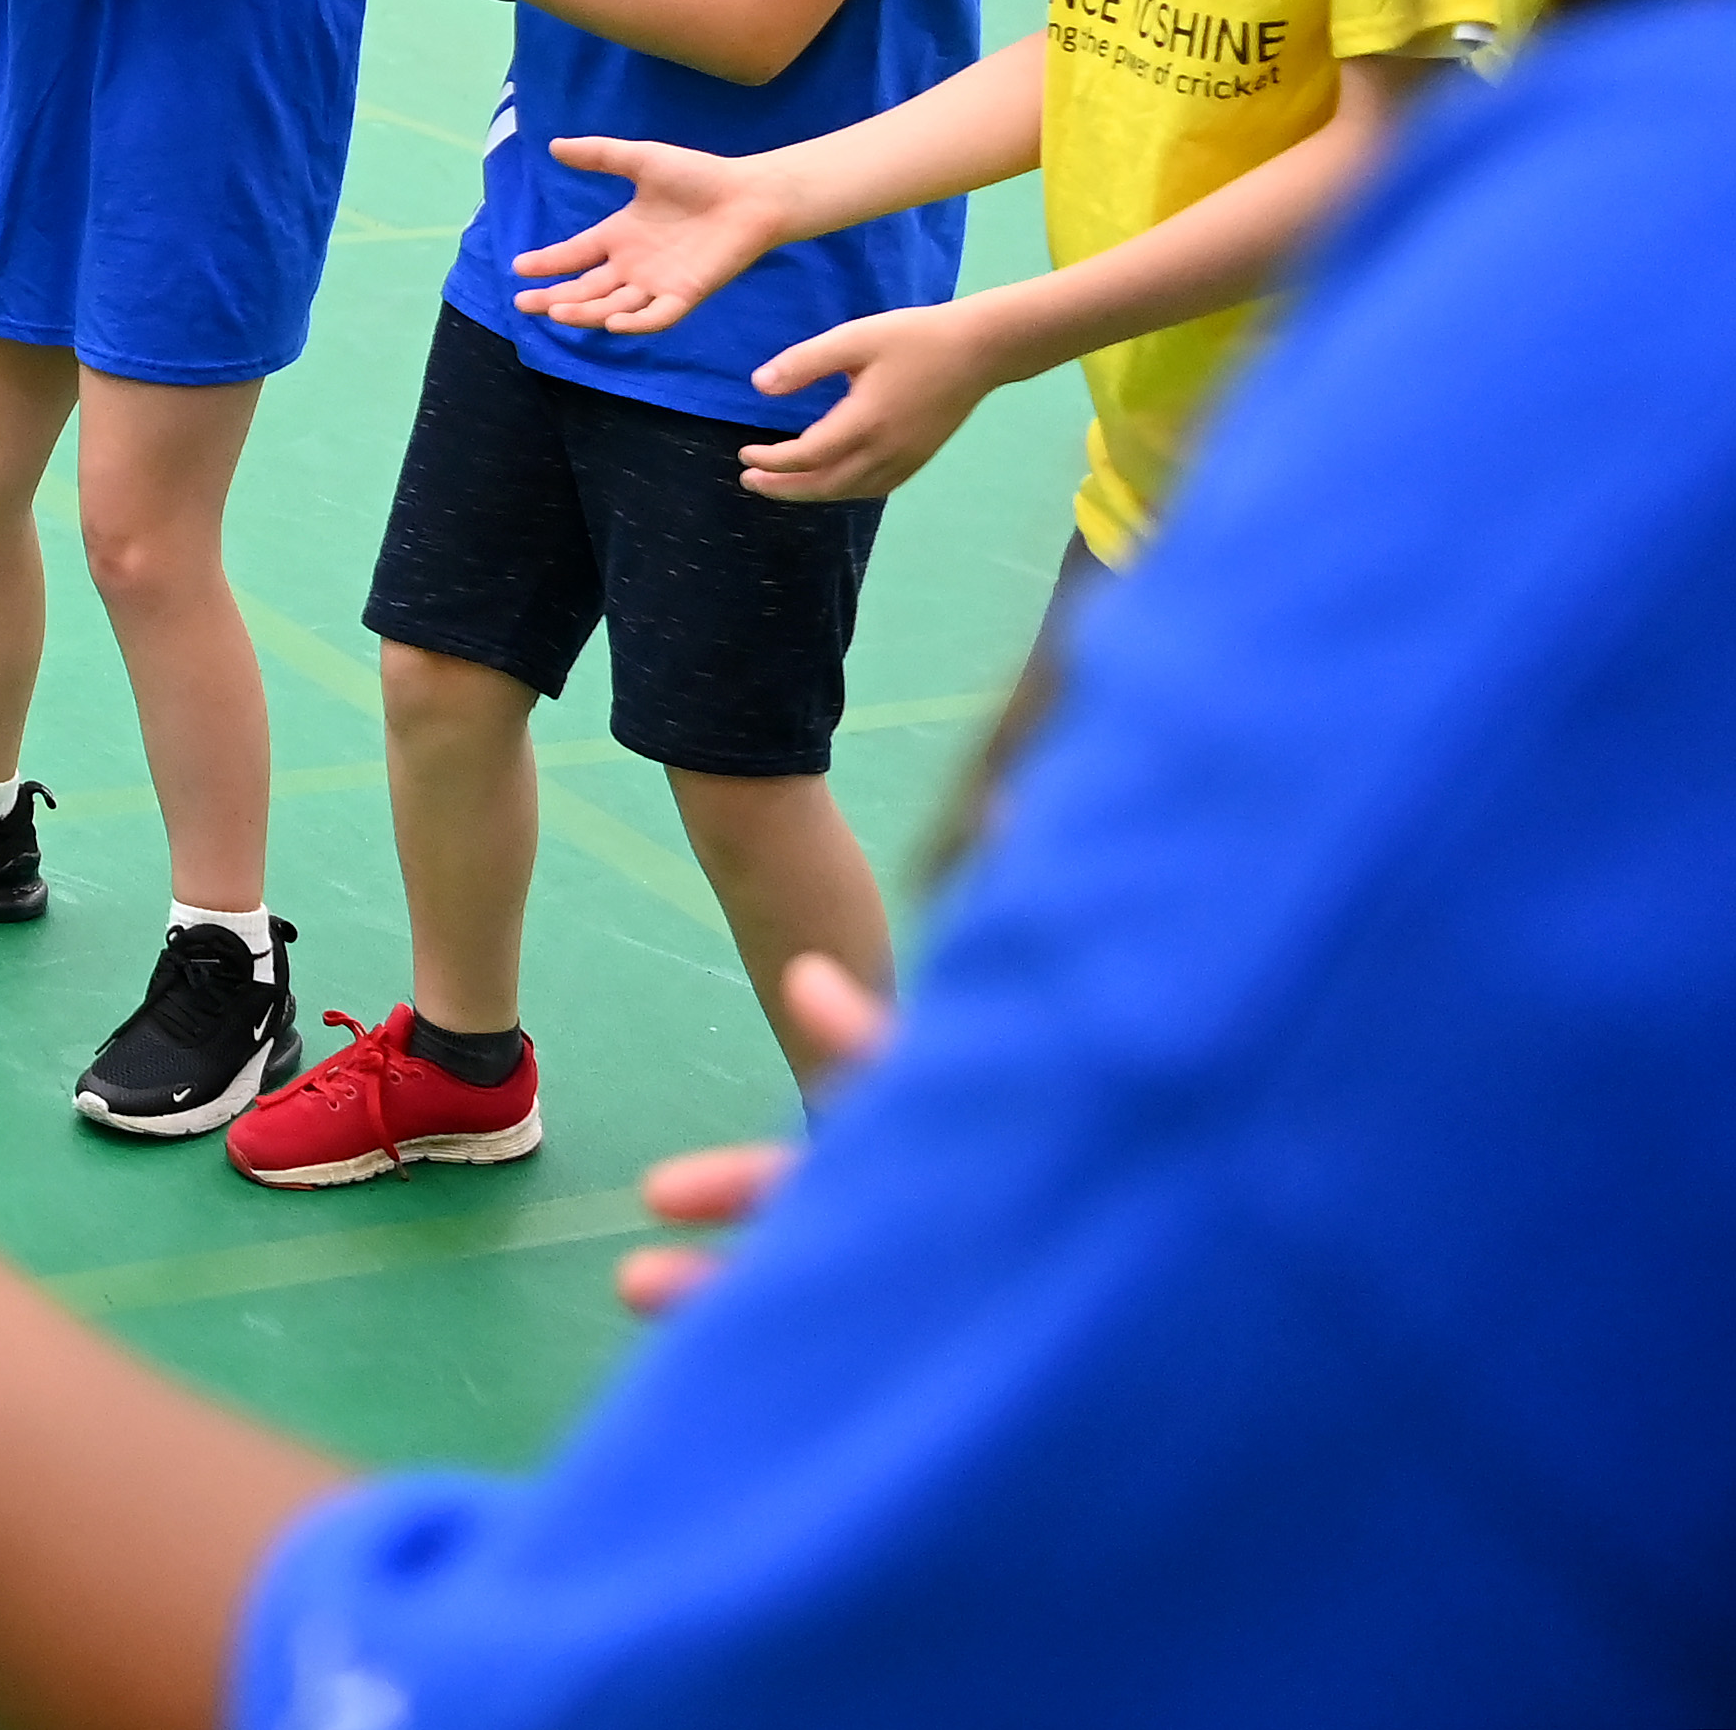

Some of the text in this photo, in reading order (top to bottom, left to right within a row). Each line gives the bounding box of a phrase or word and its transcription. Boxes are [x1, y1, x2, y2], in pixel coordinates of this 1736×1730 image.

[1047, 22, 1079, 53] ng
[1111, 44, 1151, 79] per
[1175, 66, 1281, 100] cricket
[1153, 2, 1289, 66] SHINE
